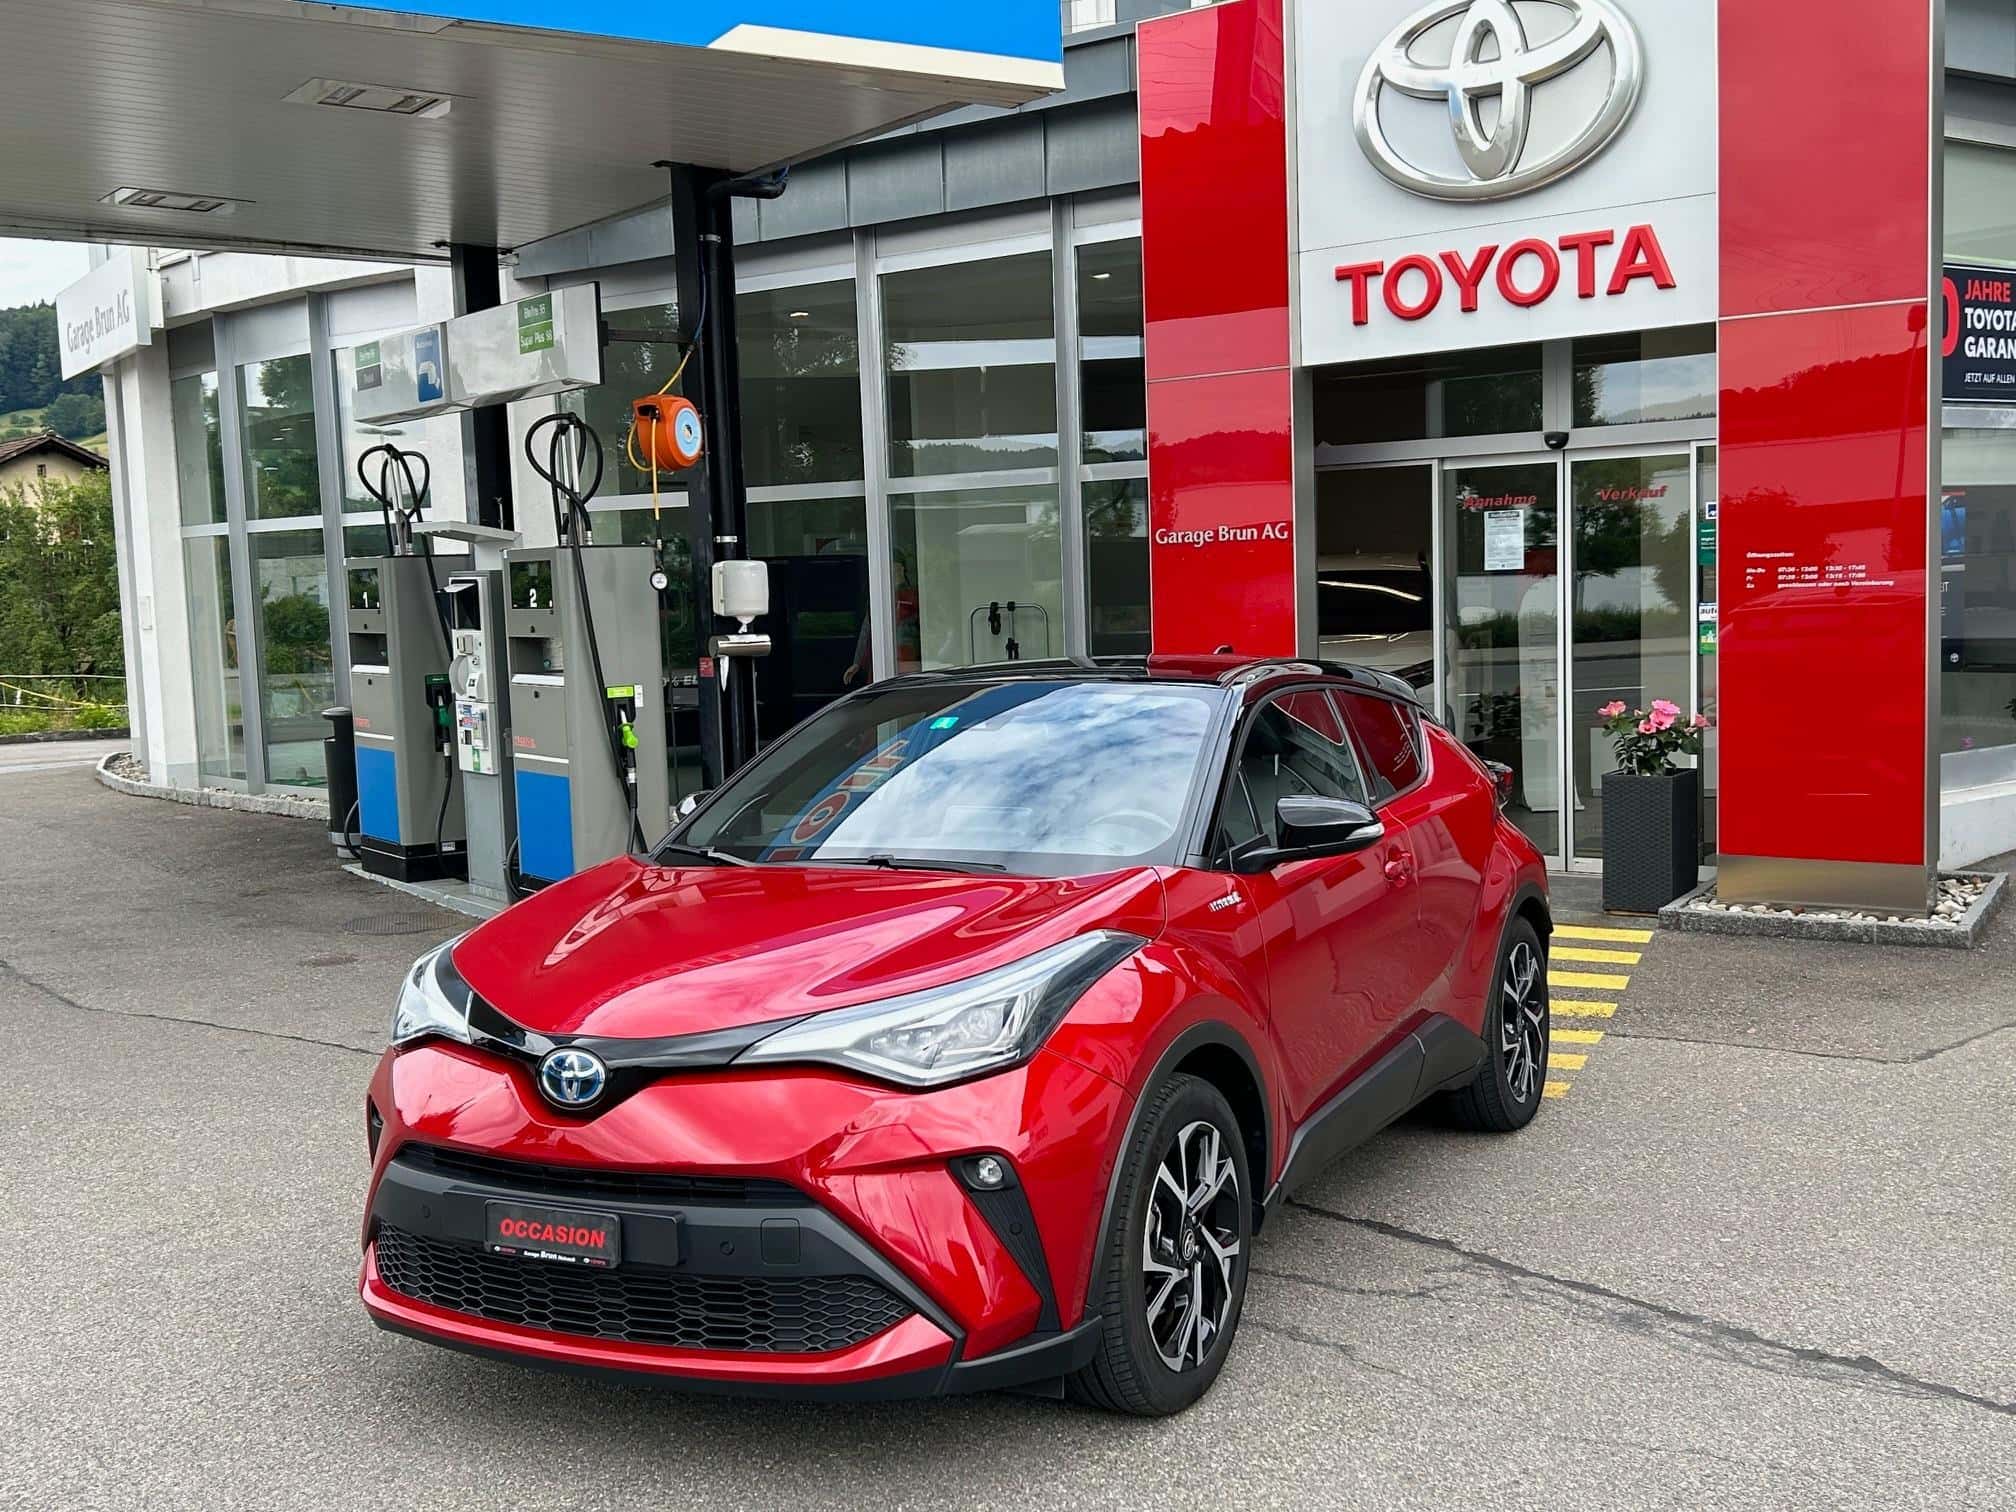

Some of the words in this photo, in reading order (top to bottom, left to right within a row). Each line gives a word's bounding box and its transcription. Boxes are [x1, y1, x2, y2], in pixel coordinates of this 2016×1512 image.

[1335, 223, 1676, 326] TOYOTA
[1965, 279, 2011, 303] JAHRE
[67, 318, 95, 355] Garage
[95, 305, 115, 339] Brun
[117, 289, 130, 328] AG
[1964, 336, 2016, 359] GARAN
[1964, 372, 1982, 383] JETZT
[1983, 373, 1996, 383] AUF
[1996, 374, 2015, 384] ALLEN
[1600, 485, 1668, 502] Verkauf
[1155, 527, 1214, 548] Garage
[1218, 525, 1258, 541] Brun
[1261, 522, 1289, 540] AG
[362, 592, 369, 608] 1
[529, 588, 538, 608] 2
[500, 1217, 606, 1249] OCCASION
[540, 1249, 557, 1261] Brun
